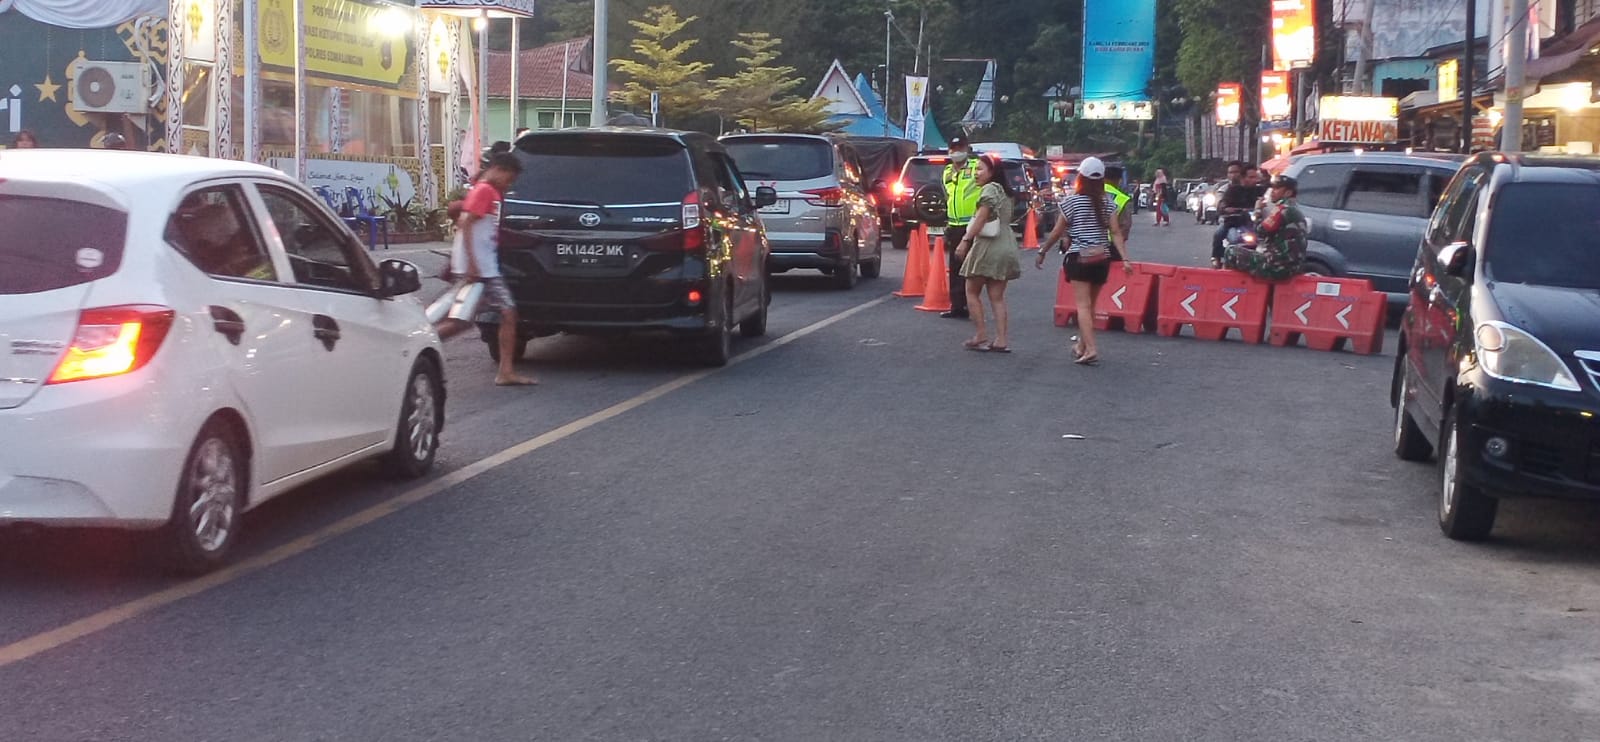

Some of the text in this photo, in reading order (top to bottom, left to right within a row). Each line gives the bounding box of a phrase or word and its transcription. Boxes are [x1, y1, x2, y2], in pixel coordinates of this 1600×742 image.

[1322, 120, 1384, 141] KETAWA
[556, 243, 625, 257] BK 1442 MK
